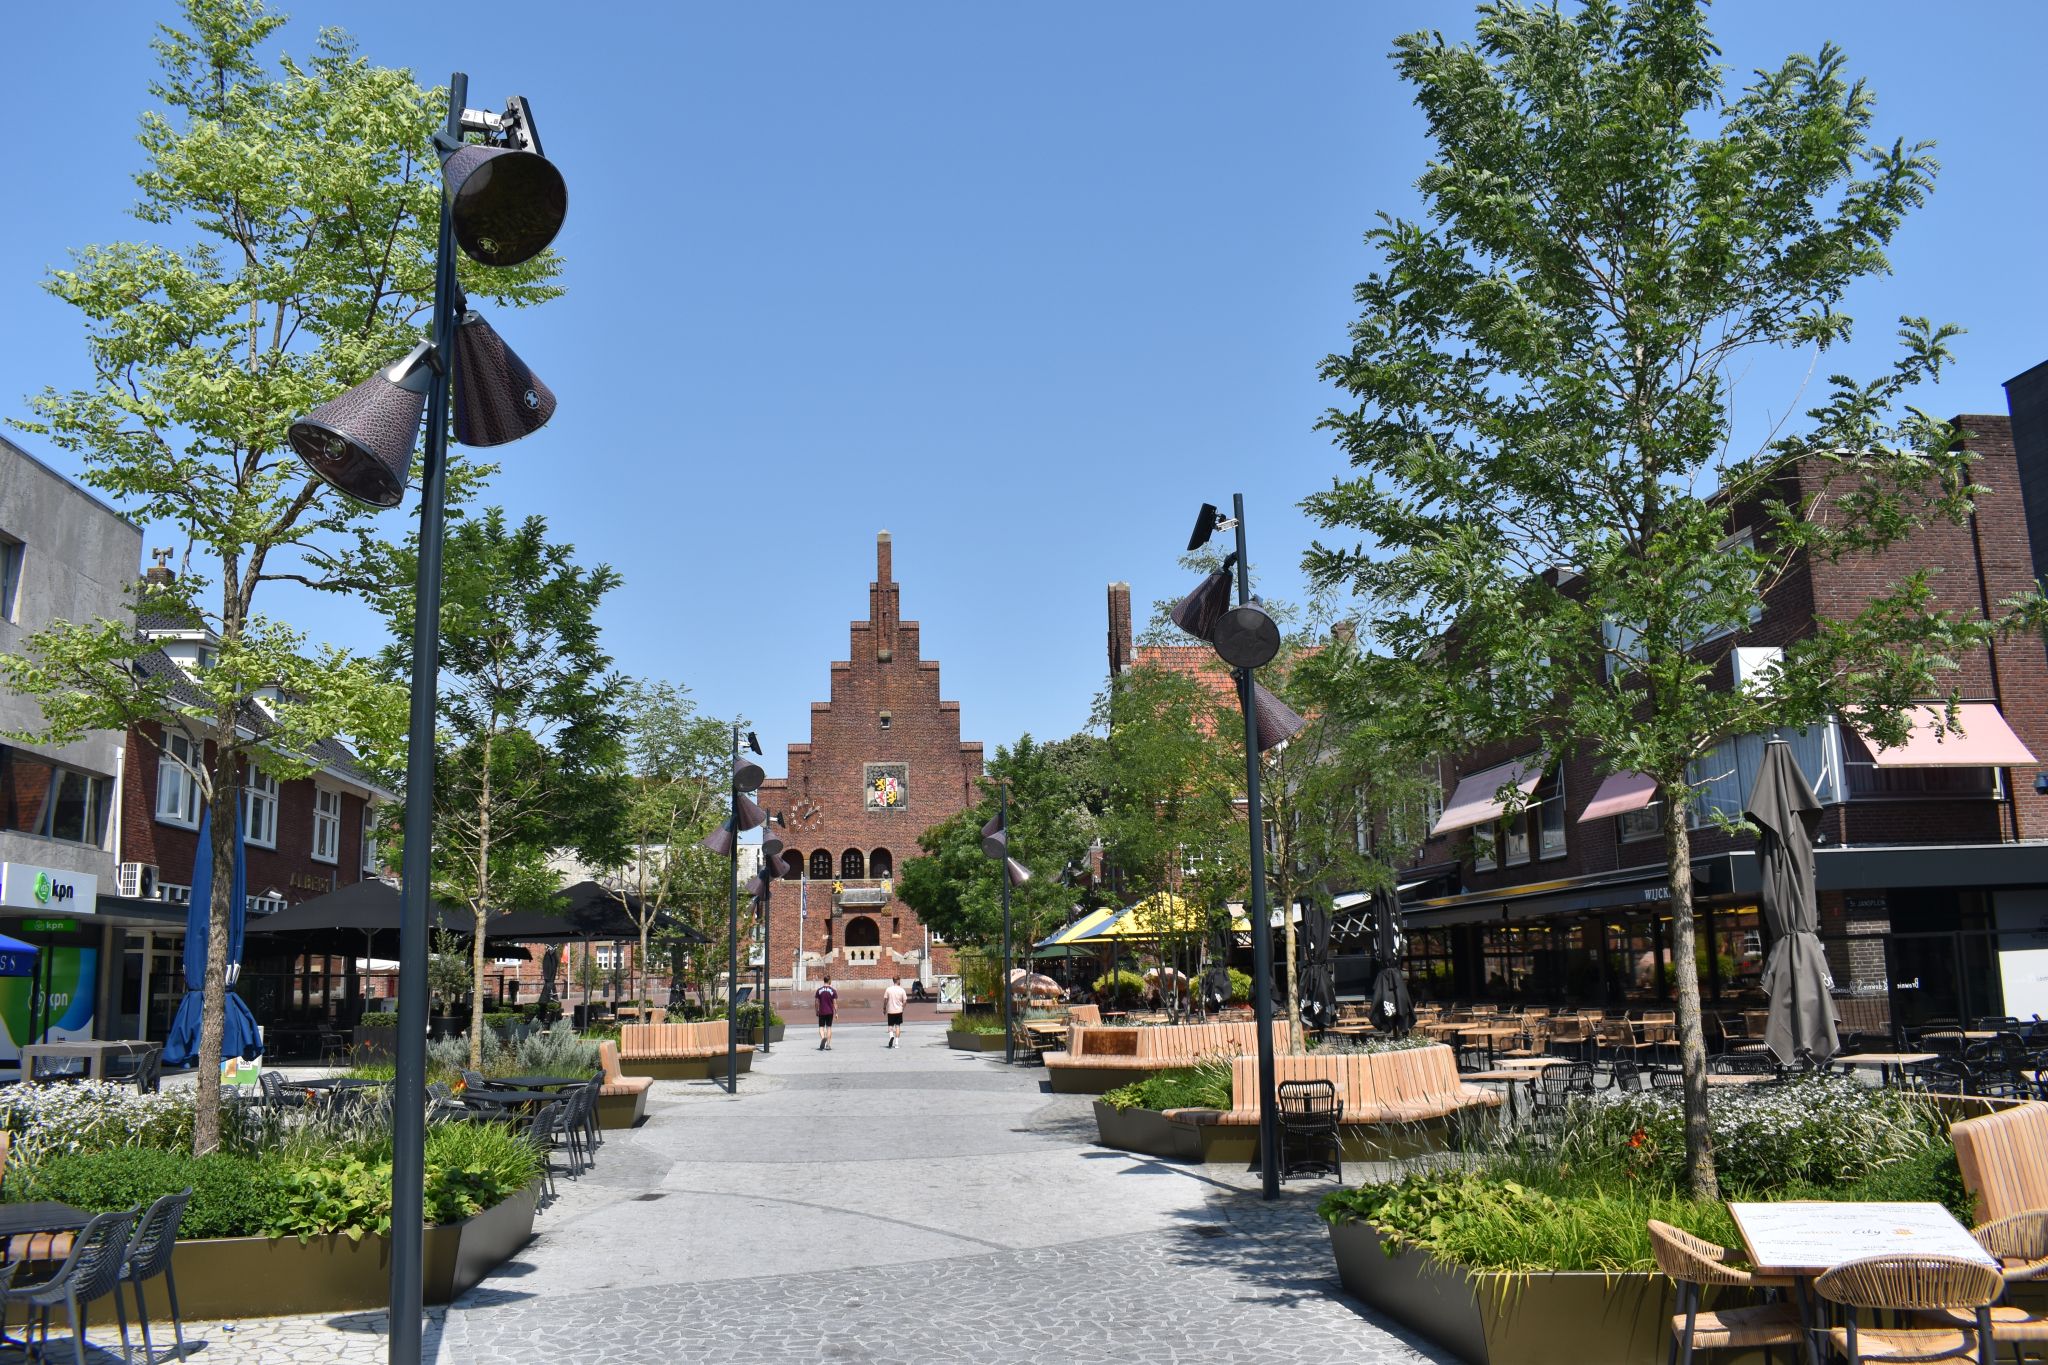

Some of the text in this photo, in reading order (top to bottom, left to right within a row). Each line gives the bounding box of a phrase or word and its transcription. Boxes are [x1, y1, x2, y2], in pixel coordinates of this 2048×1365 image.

[51, 879, 74, 902] kpn
[1644, 887, 1671, 900] WIJCK
[46, 921, 64, 929] kpn
